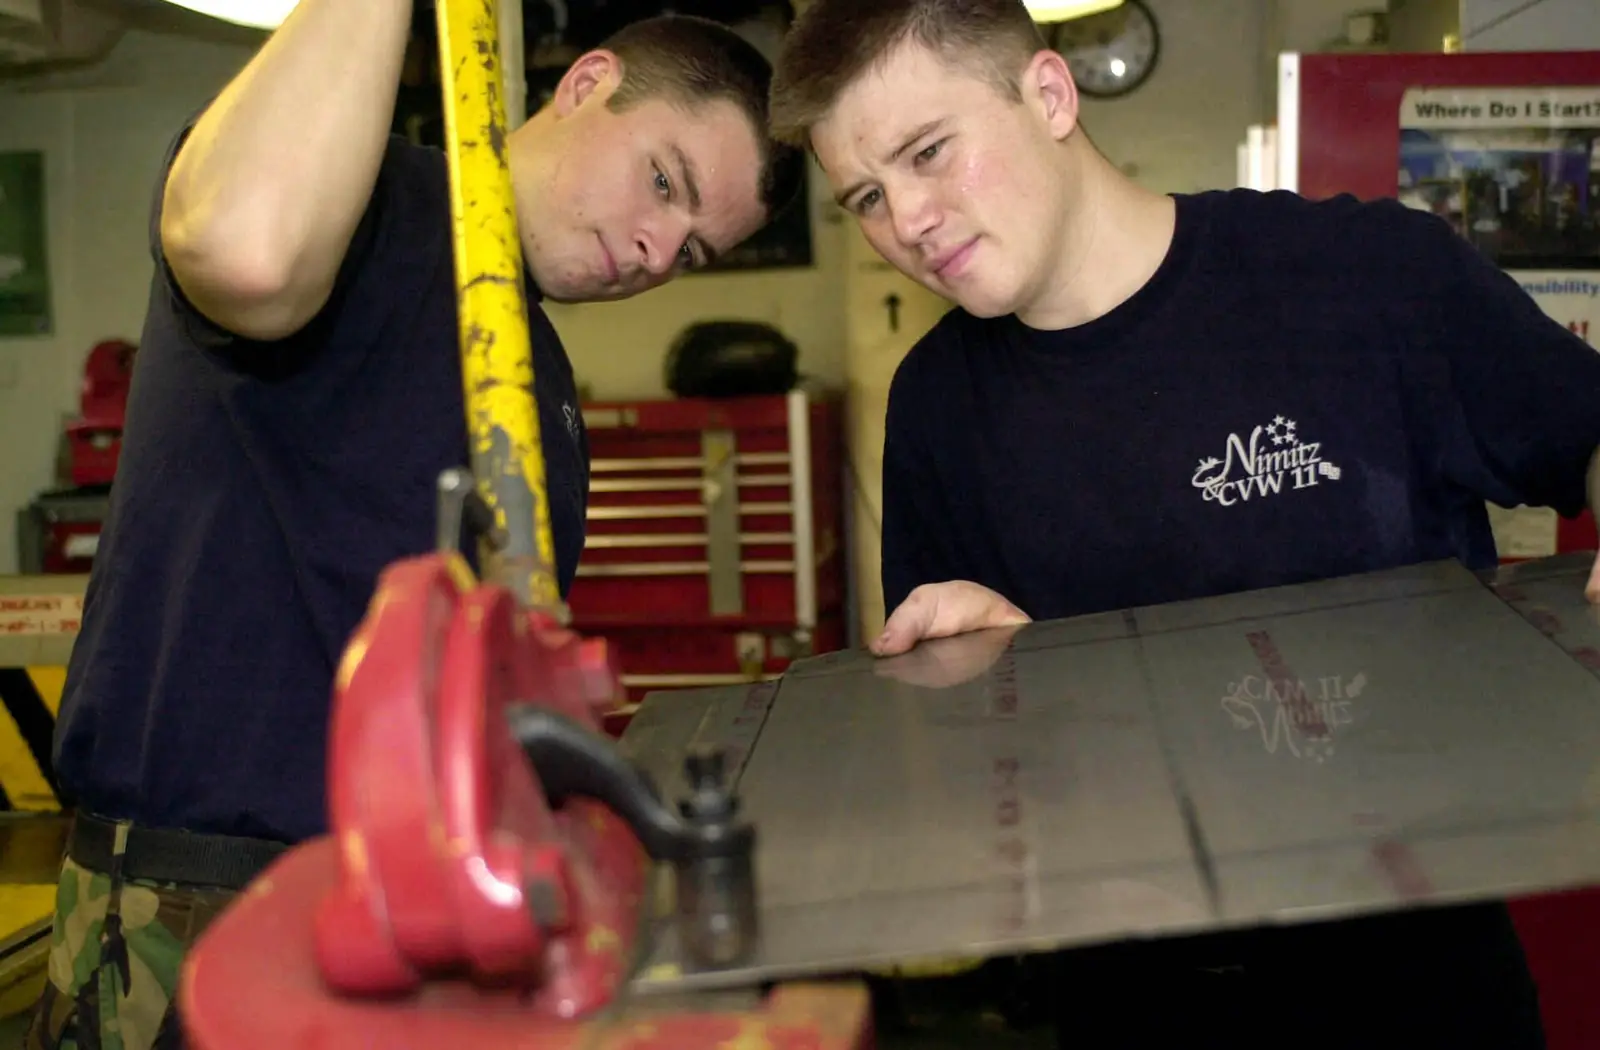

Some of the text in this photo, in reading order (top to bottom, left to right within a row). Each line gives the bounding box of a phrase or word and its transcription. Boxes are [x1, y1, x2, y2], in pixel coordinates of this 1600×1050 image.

[1416, 101, 1482, 119] Where
[1489, 101, 1518, 119] Do
[1525, 102, 1532, 118] I
[1521, 280, 1600, 299] nsibility
[1191, 424, 1322, 488] Nimitz
[1219, 470, 1284, 506] CVW
[1291, 463, 1319, 490] 11
